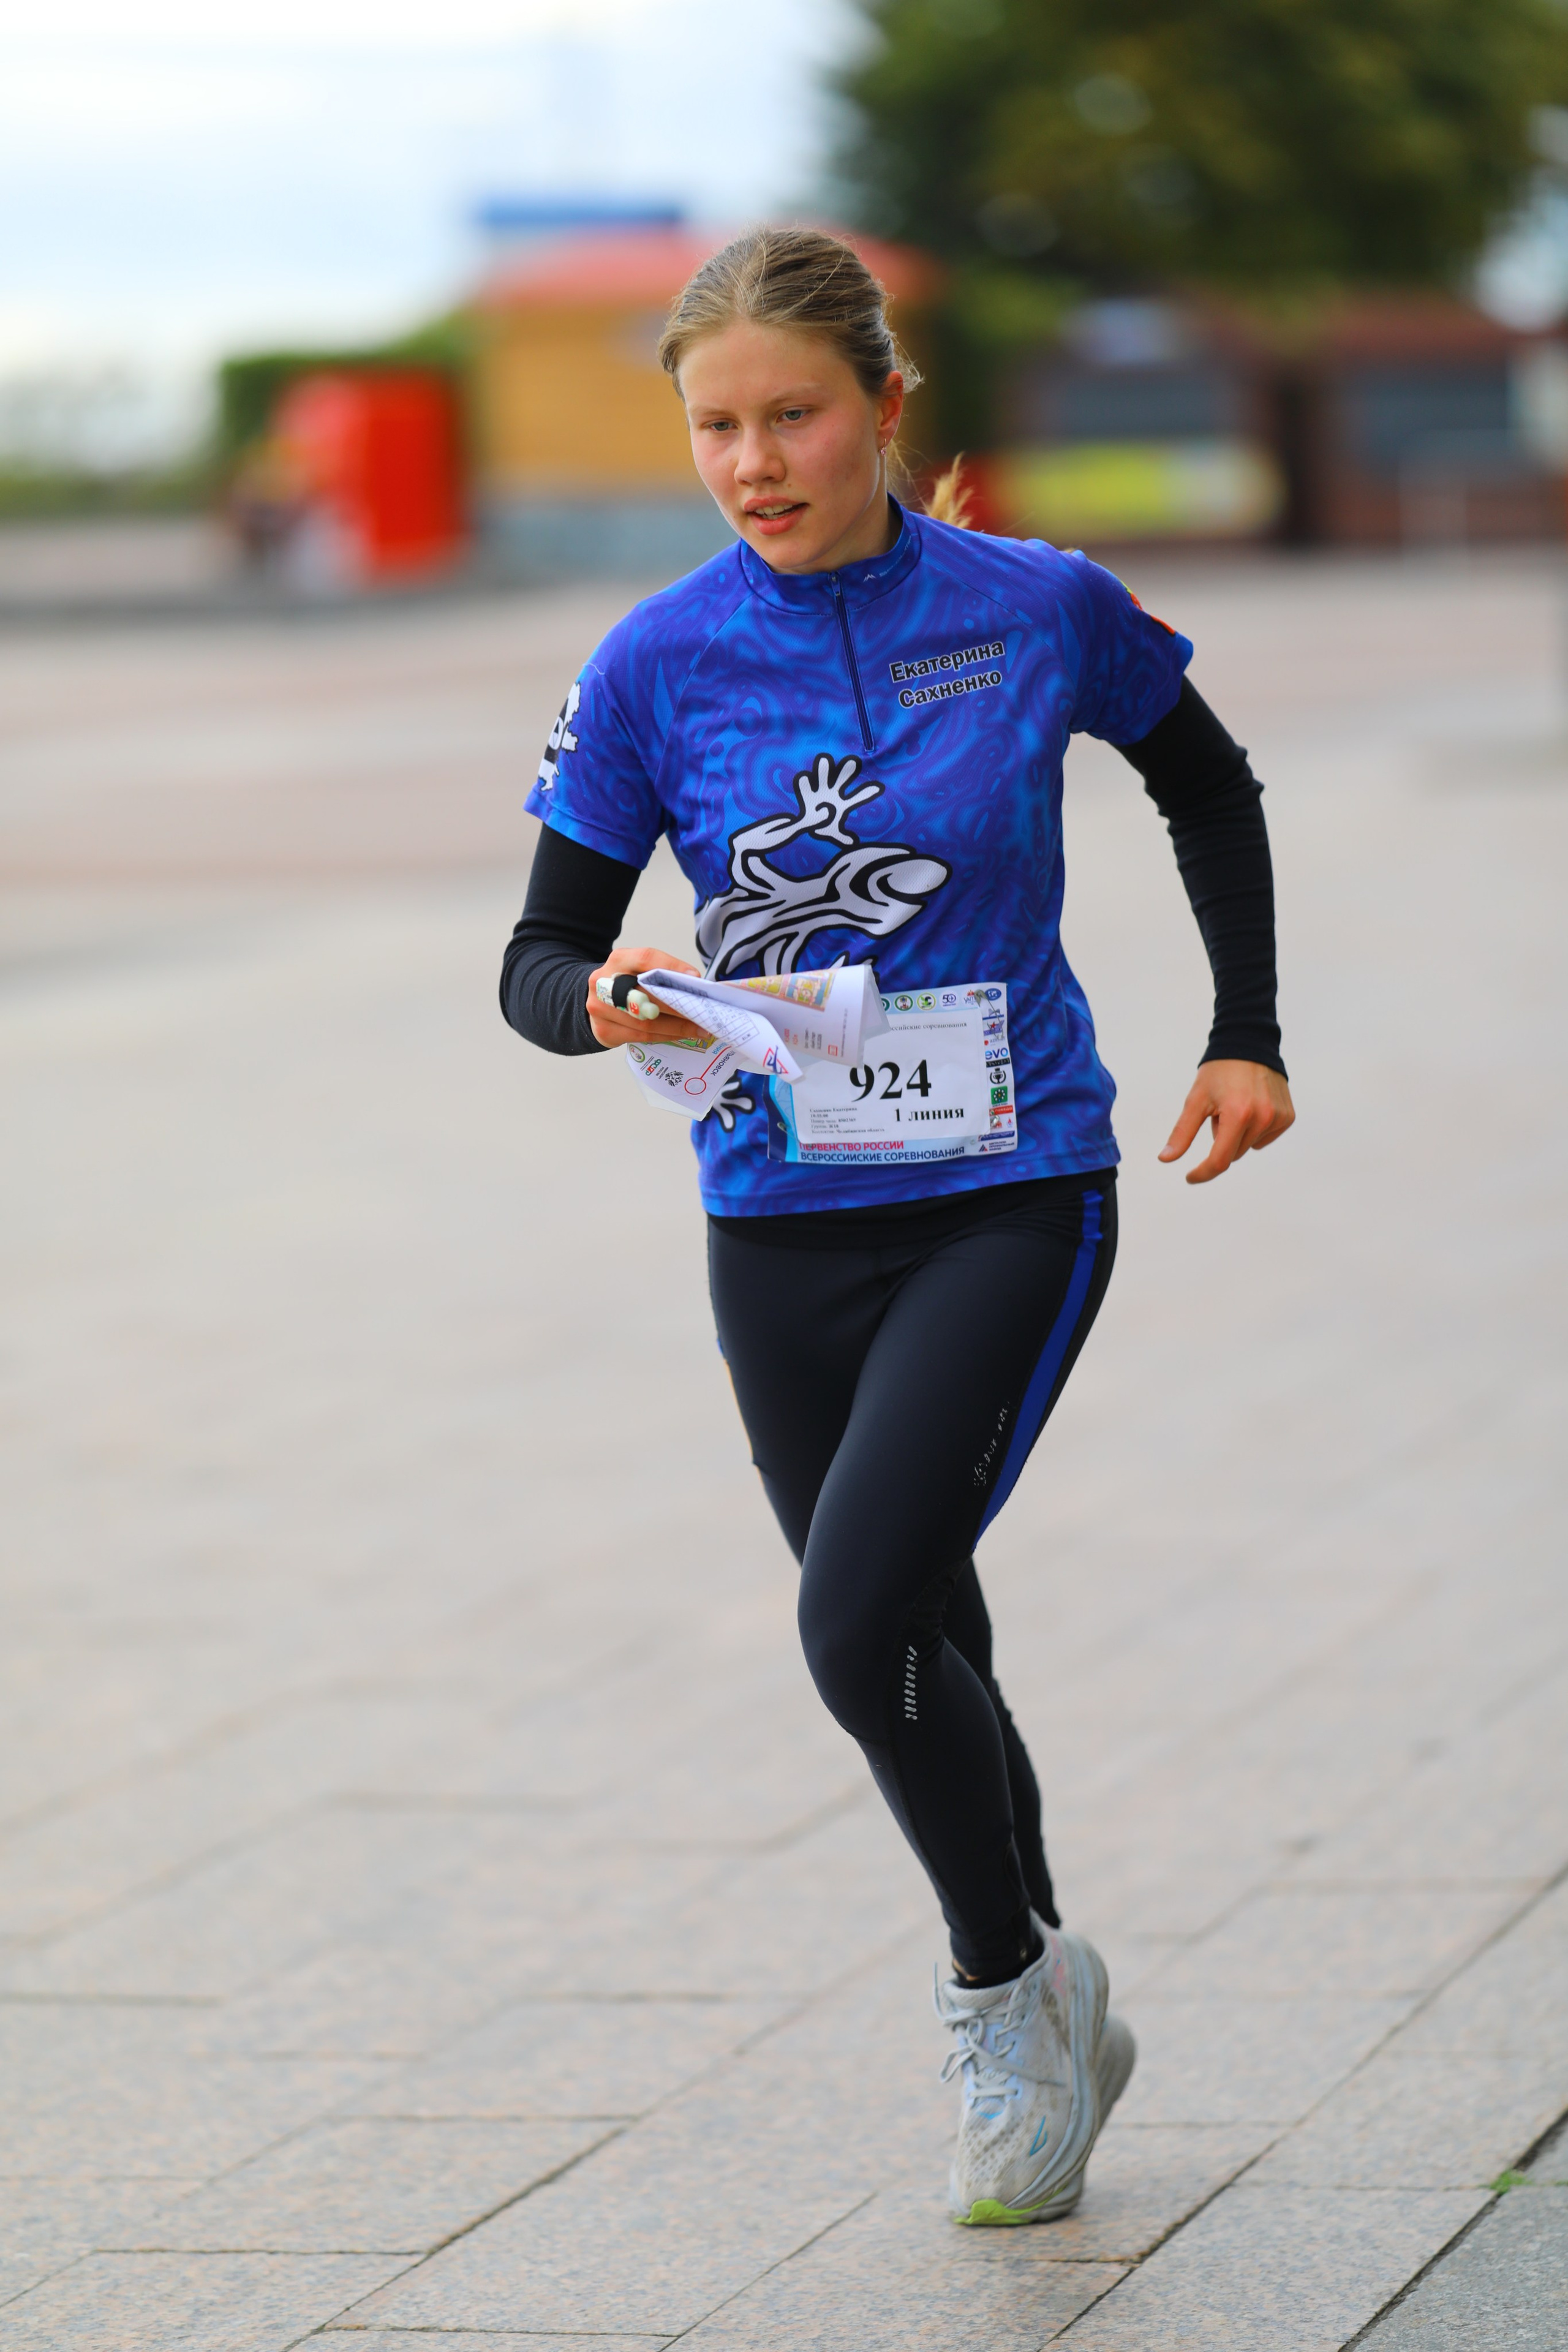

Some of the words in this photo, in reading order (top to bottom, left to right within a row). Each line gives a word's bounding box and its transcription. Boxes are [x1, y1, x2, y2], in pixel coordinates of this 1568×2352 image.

[889, 641, 1006, 682] Екатерина
[899, 671, 1002, 709] Сахненко
[985, 1047, 1008, 1060] evo
[850, 1059, 932, 1102] 924
[894, 1108, 900, 1121] 1
[908, 1108, 964, 1121] линия
[799, 1142, 861, 1152] ПЕРВЕНСТВО
[864, 1140, 904, 1151] РОССИИ
[884, 1147, 965, 1161] СОРЕВНОВАНИЯ
